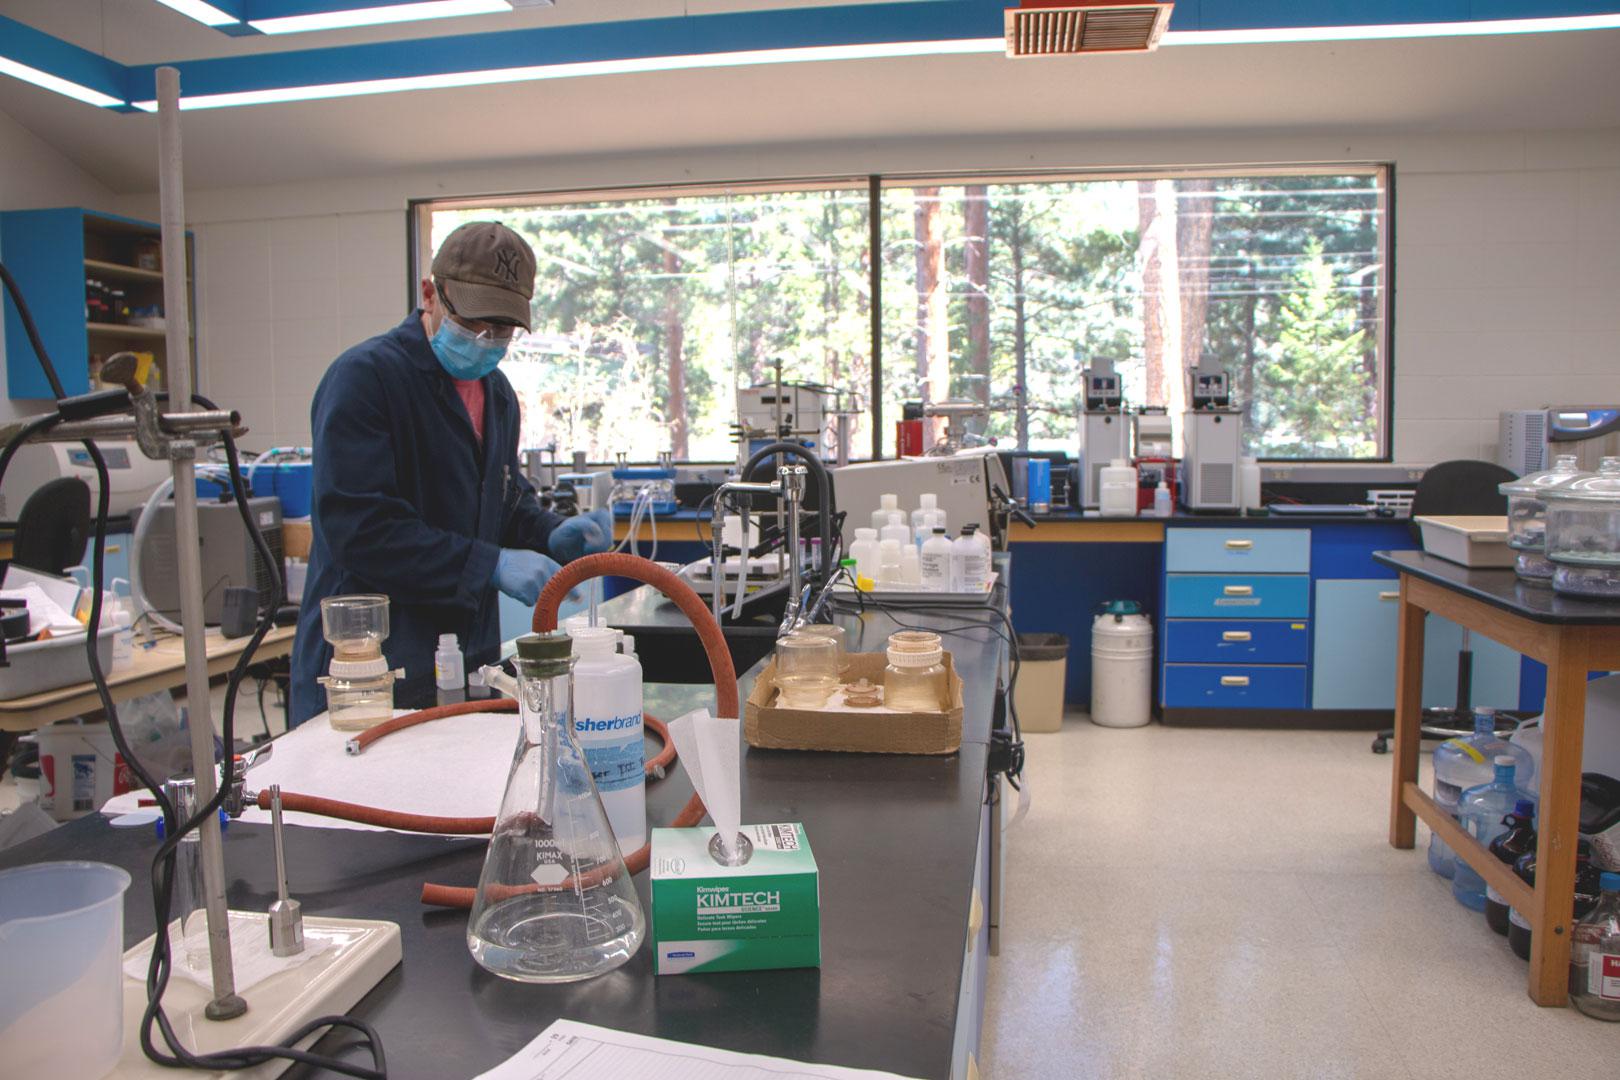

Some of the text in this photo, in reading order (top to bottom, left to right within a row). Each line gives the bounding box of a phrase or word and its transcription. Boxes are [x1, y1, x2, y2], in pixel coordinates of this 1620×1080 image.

[495, 249, 520, 281] NY
[574, 710, 642, 731] sherbrand
[537, 851, 563, 861] KIMAX
[602, 876, 613, 887] 600
[697, 891, 780, 907] KIMTECH
